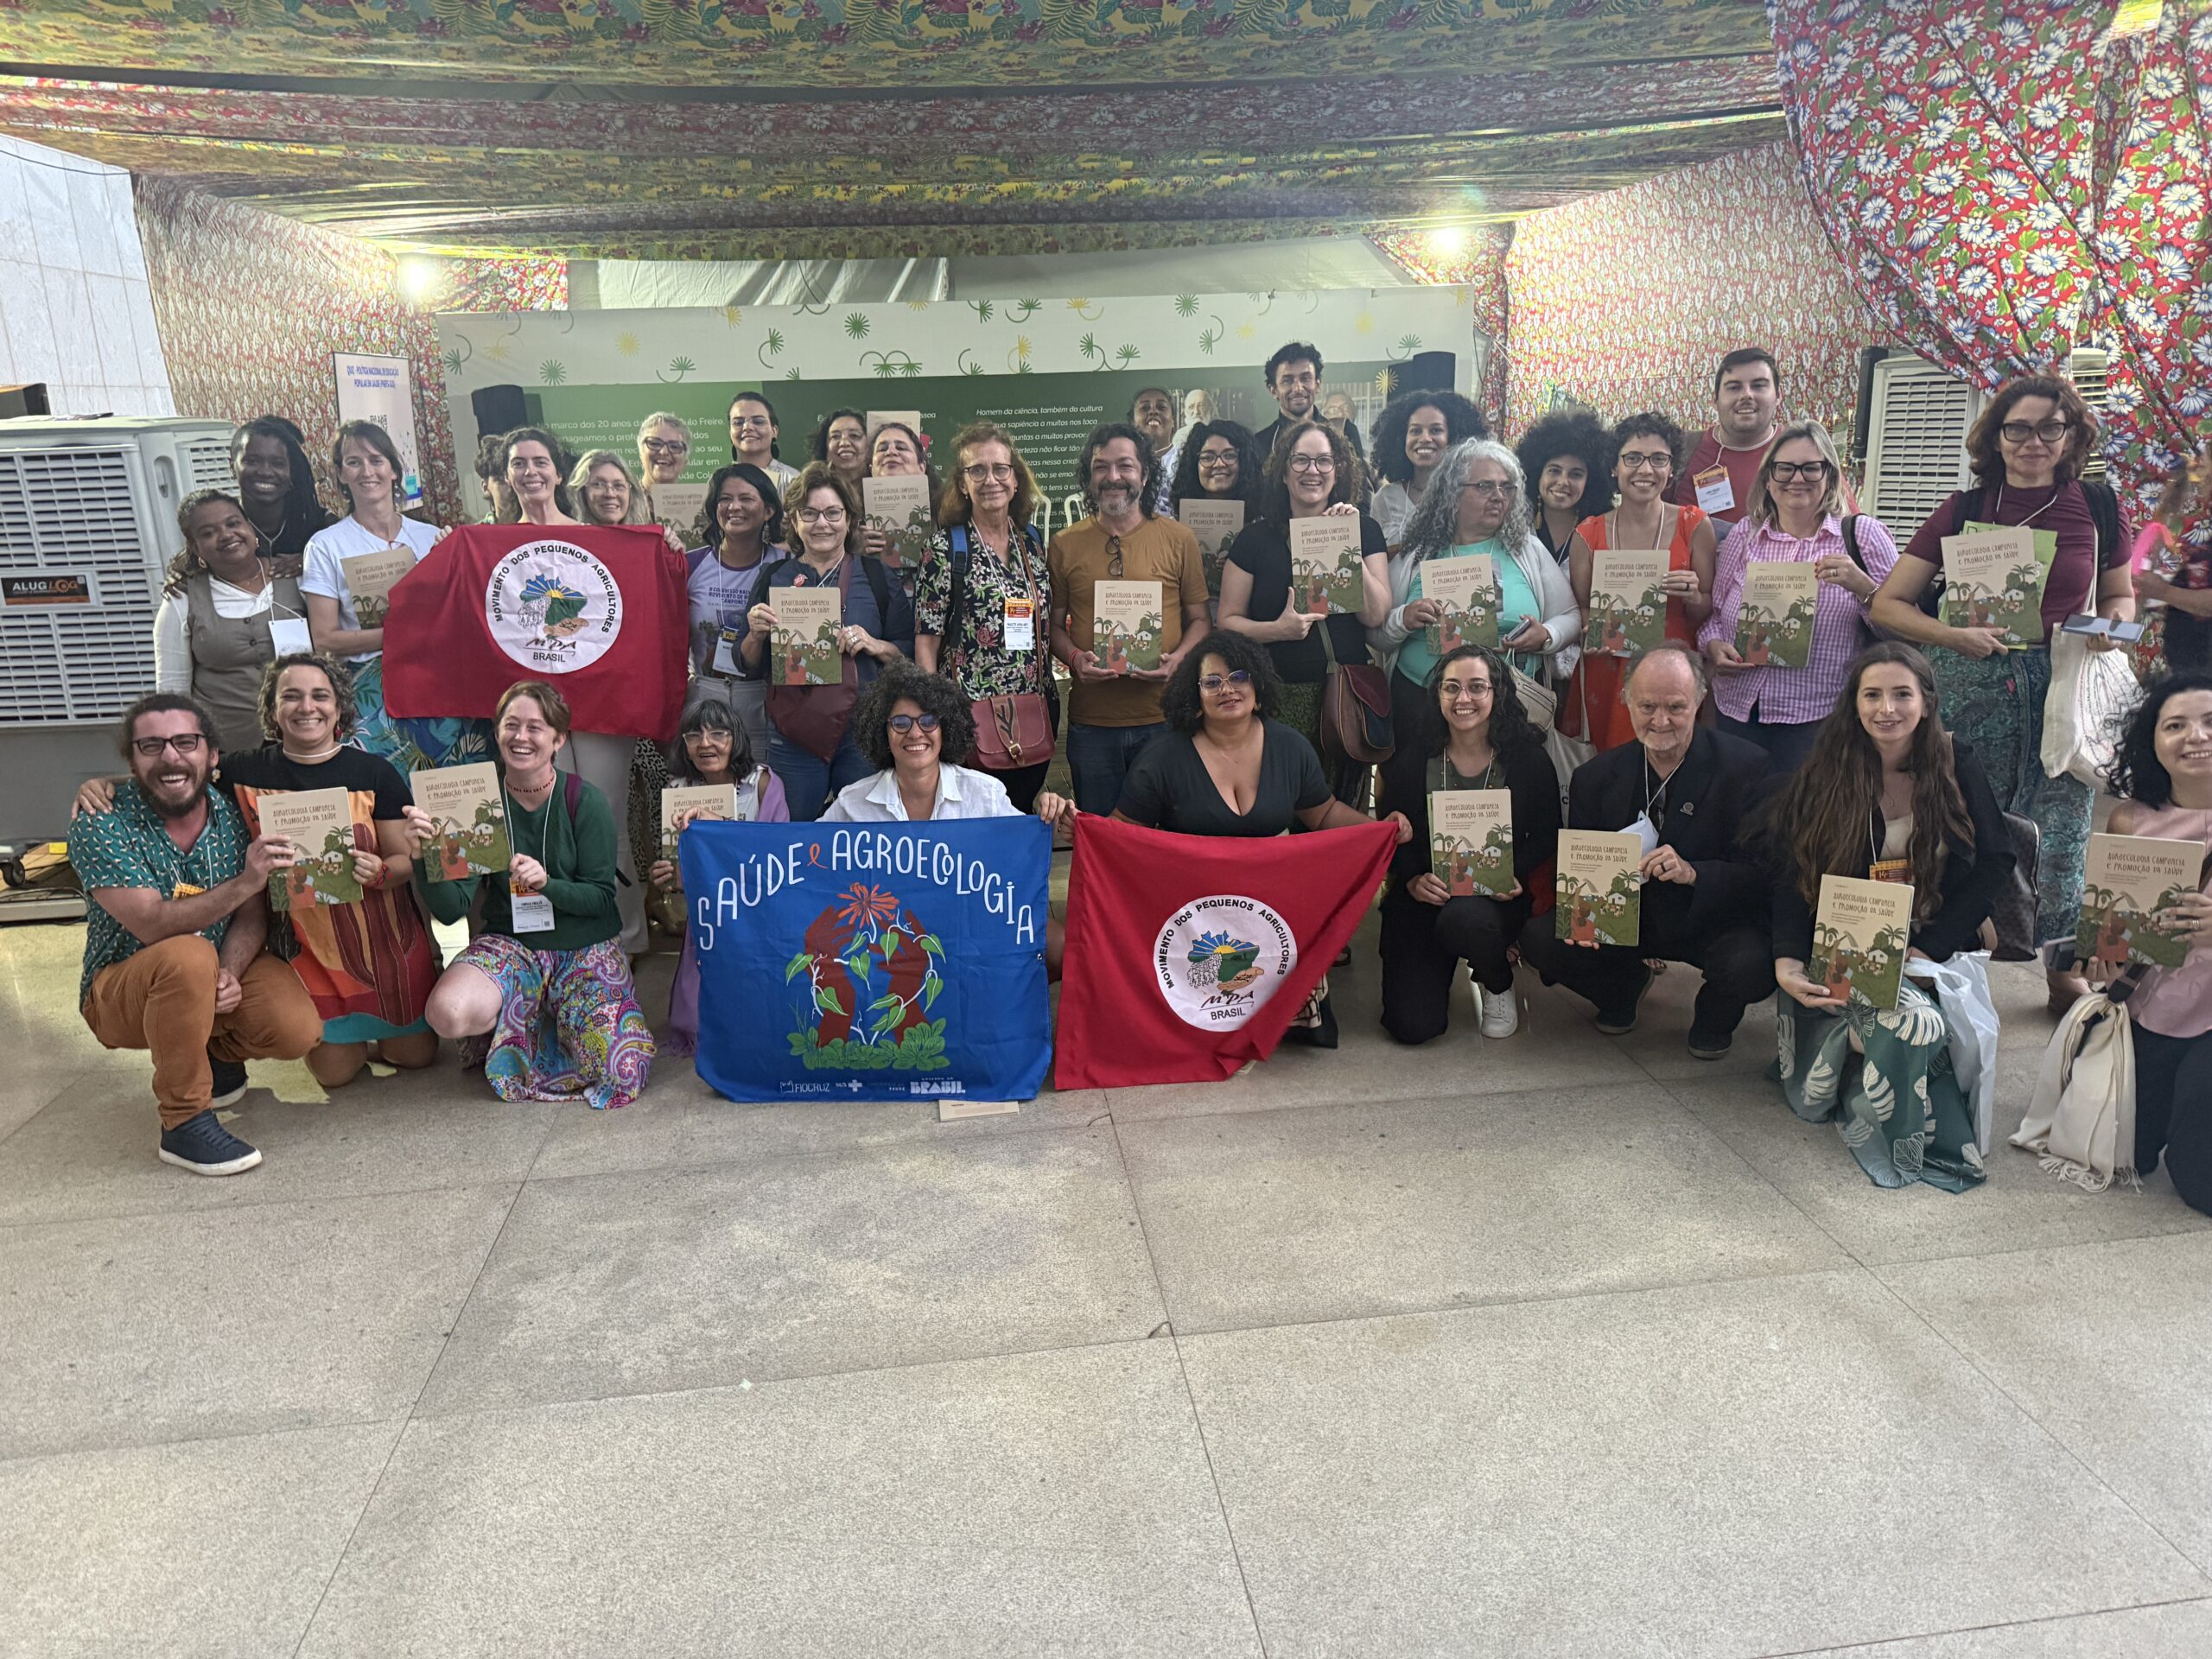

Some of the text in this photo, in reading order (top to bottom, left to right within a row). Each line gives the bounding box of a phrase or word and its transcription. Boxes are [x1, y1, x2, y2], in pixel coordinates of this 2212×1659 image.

[492, 545, 616, 633] MOVIMENTO DOS PEQUENOS AGRICULTORES
[533, 652, 565, 663] BRASIL
[697, 830, 1034, 950] SAÚDE e AGROECOLOGIA
[1159, 899, 1290, 988] MOVIMENTO DOS PEQUENOS AGRICULTORES
[1211, 1007, 1246, 1020] BRASIL
[795, 1083, 830, 1093] FIOCRUZ
[910, 1081, 966, 1095] BRASIL
